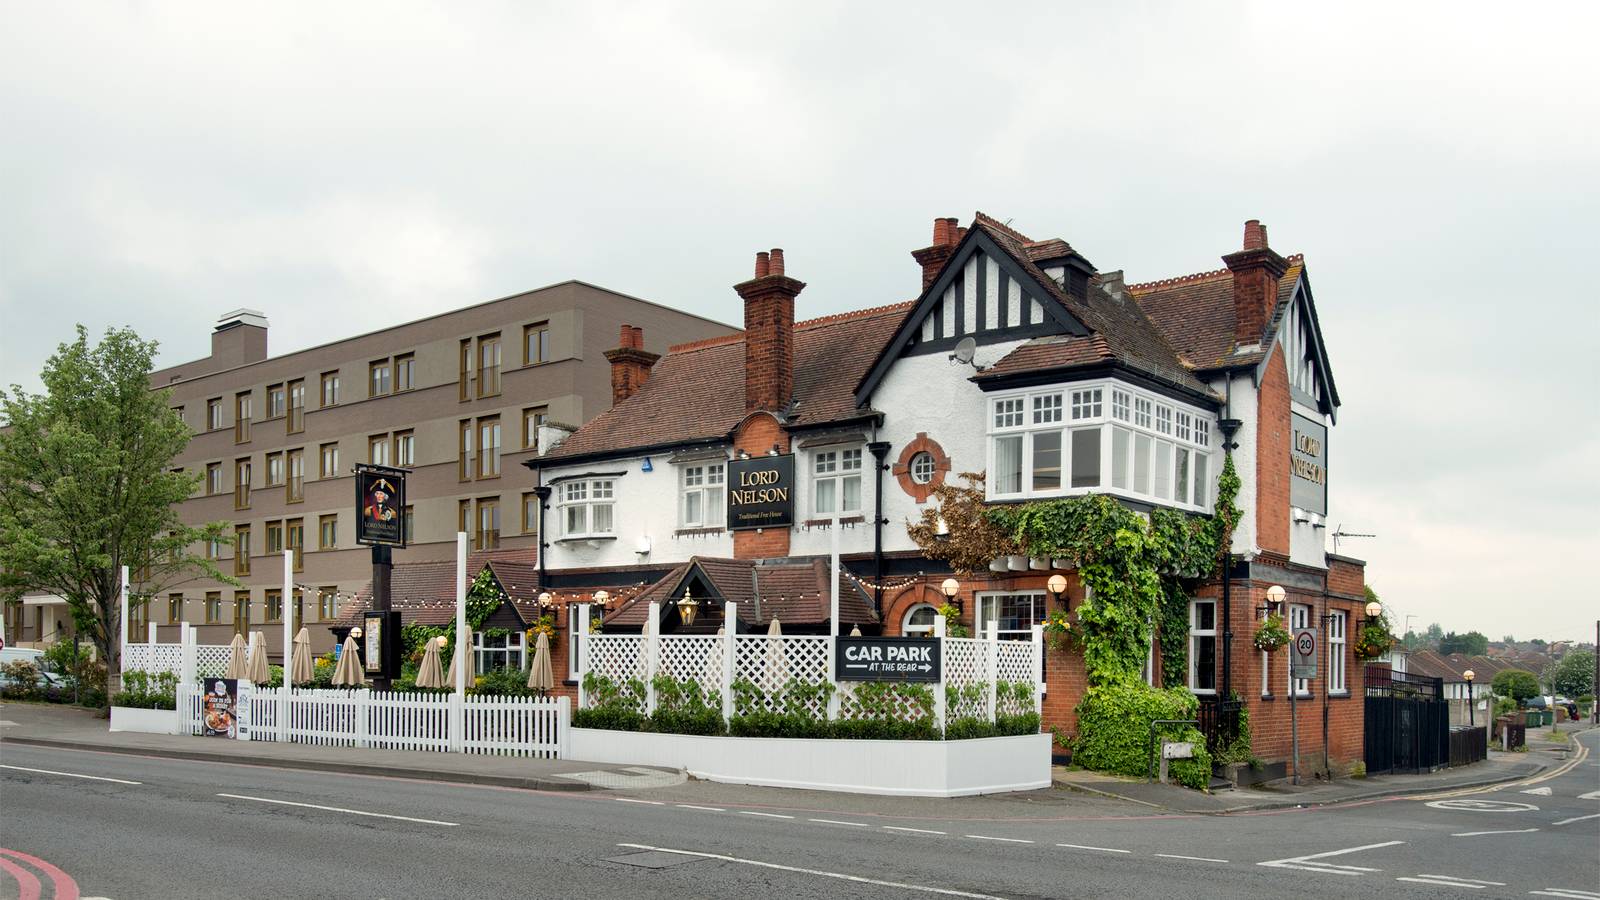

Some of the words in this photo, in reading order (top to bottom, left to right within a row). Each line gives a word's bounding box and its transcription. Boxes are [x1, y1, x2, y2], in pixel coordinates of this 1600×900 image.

[1294, 430, 1321, 457] LORD
[740, 470, 779, 487] LORD
[731, 487, 788, 506] NELSON
[1300, 639, 1312, 649] 20
[845, 646, 883, 661] CAR
[887, 646, 932, 662] PARK
[868, 662, 879, 672] AT
[881, 662, 896, 672] THE
[896, 663, 918, 672] REAR
